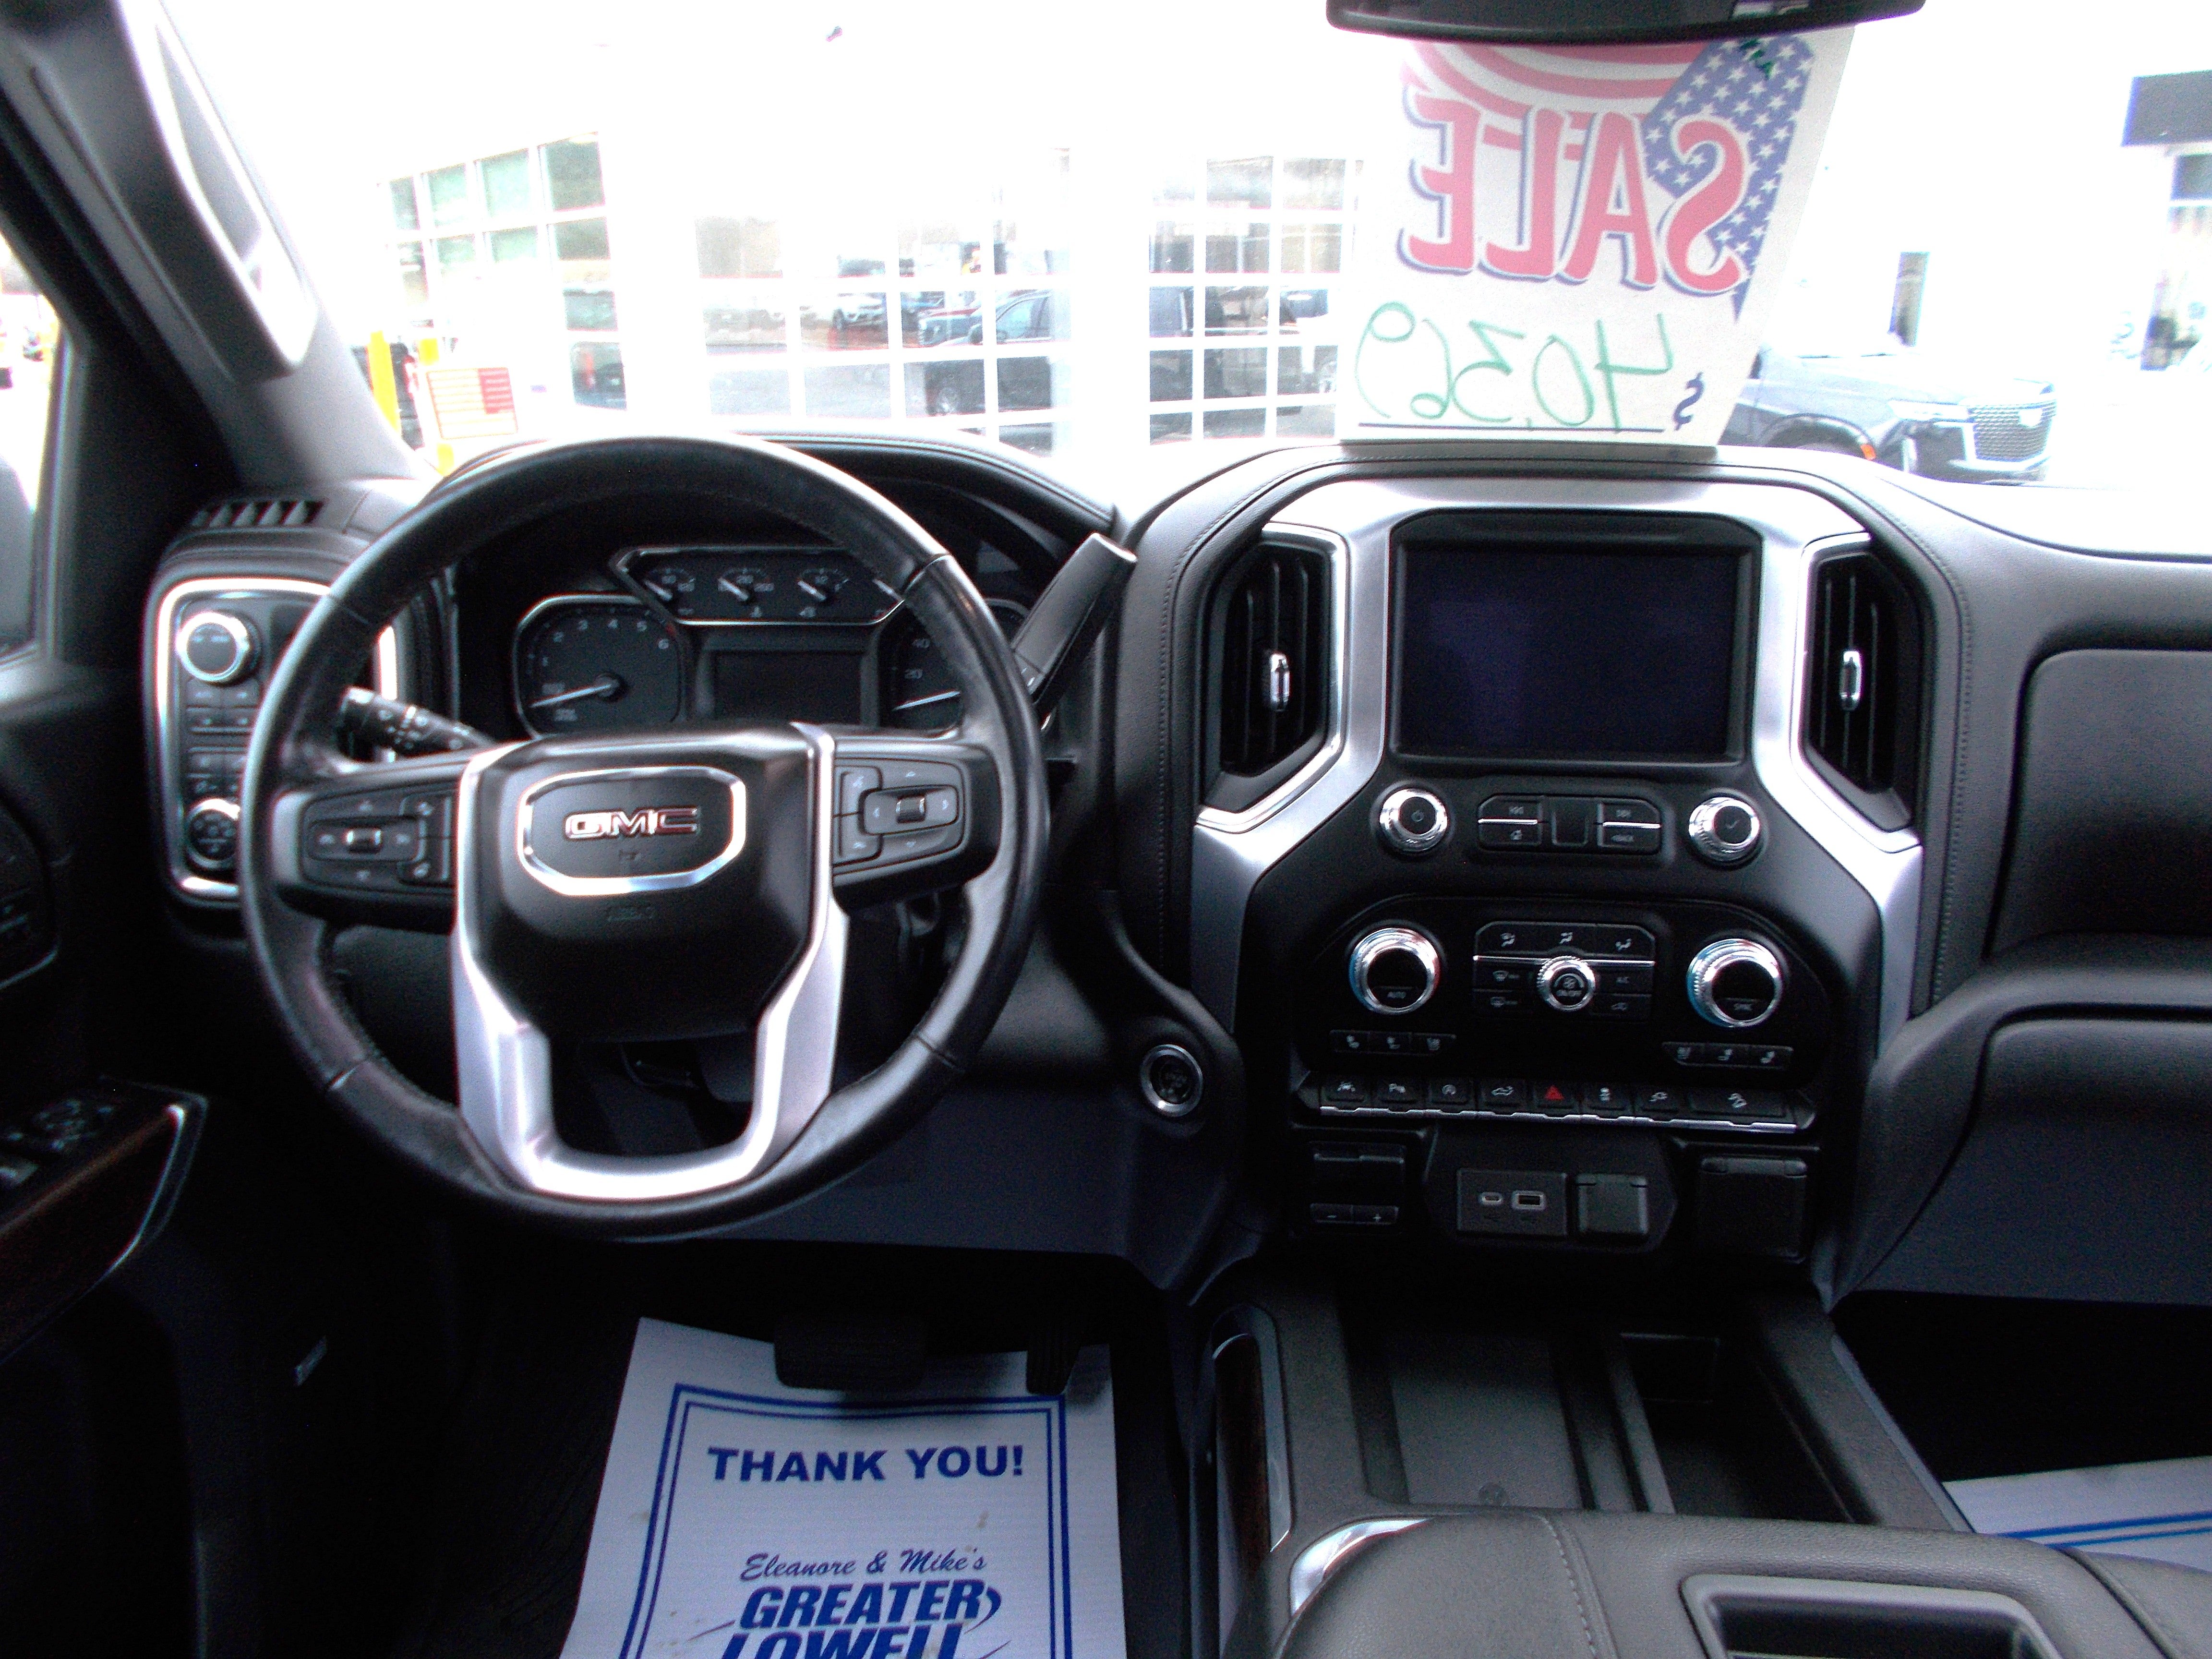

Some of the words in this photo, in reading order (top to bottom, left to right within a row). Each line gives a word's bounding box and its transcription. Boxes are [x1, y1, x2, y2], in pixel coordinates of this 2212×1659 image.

[565, 807, 697, 840] GMC
[708, 1447, 887, 1482] THANK
[906, 1445, 1023, 1480] YOU!
[740, 1552, 856, 1582] Eleanore
[866, 1550, 888, 1574] &
[900, 1547, 988, 1574] Mike's
[739, 1579, 986, 1630] GREATER
